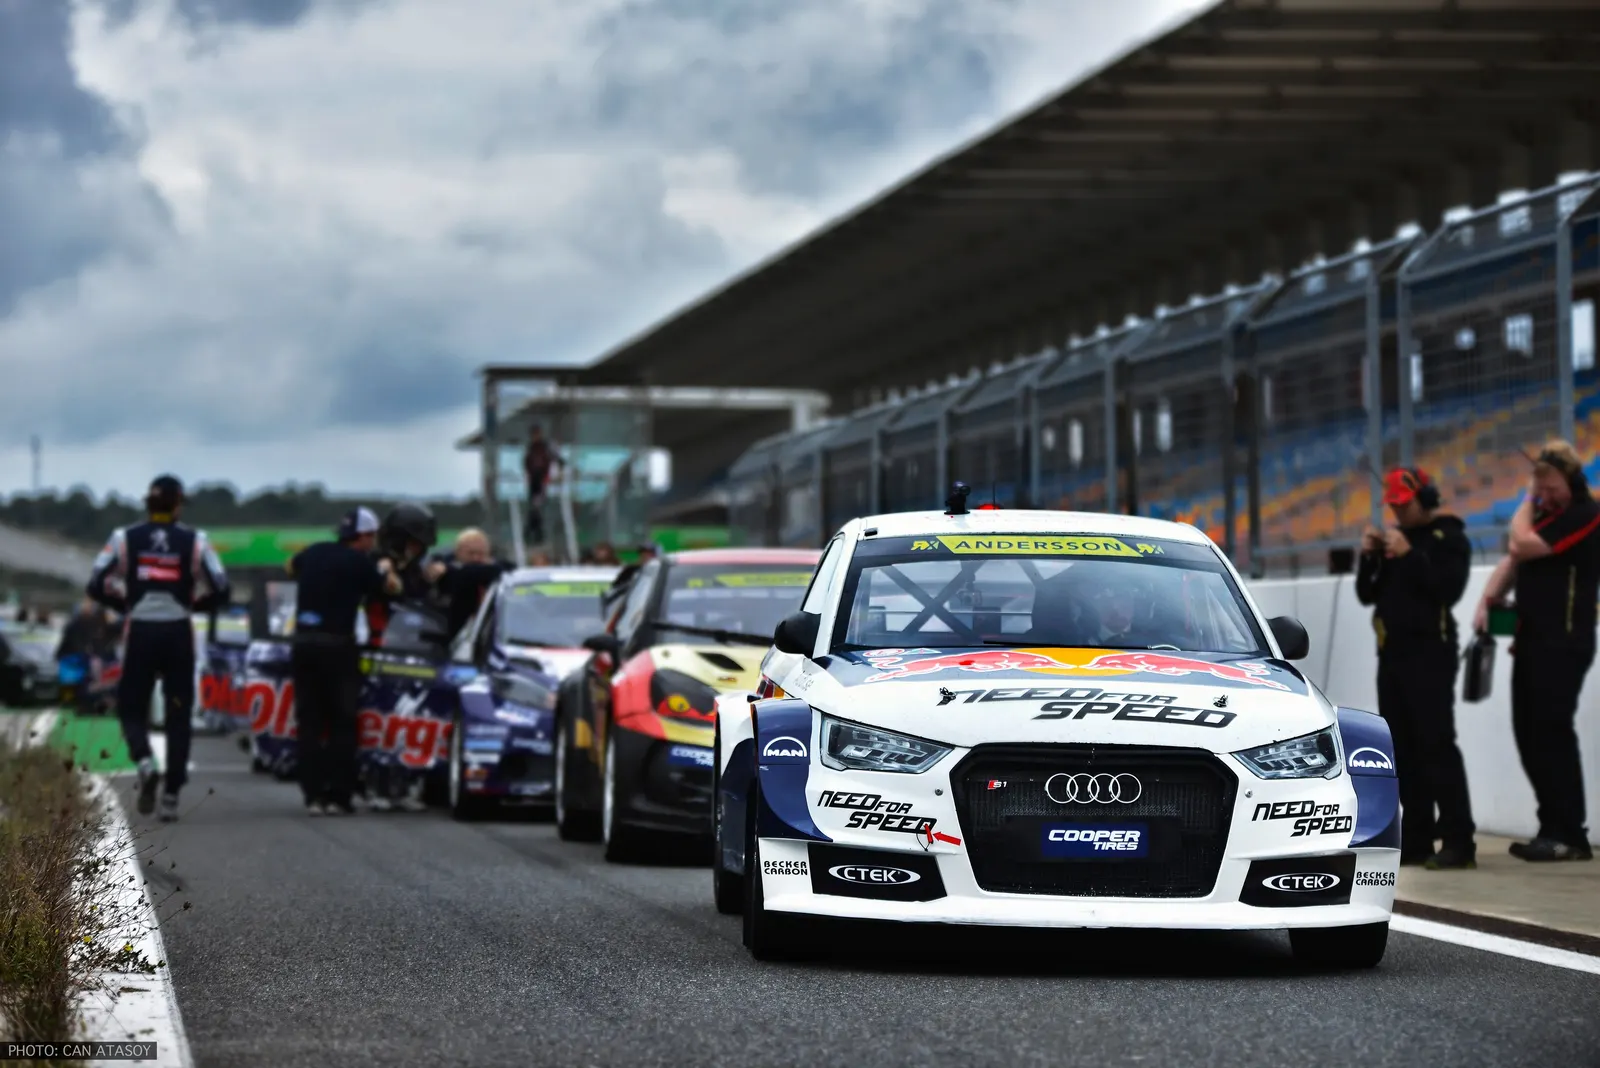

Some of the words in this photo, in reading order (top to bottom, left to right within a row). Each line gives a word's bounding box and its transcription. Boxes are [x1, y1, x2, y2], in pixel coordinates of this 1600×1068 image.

[955, 540, 1122, 552] ANDERSSON
[937, 687, 1103, 706] NEED
[1094, 693, 1178, 704] FOR
[1031, 702, 1238, 728] SPEED
[766, 749, 804, 757] MAN
[1352, 759, 1390, 769] MAN
[818, 790, 881, 811] NEED
[874, 801, 913, 814] FOR
[1252, 800, 1315, 822] NEED
[1313, 804, 1340, 816] FOR
[845, 811, 937, 834] SPEED
[1290, 815, 1352, 837] SPEED
[1048, 829, 1140, 842] COOPER
[1093, 841, 1138, 850] TIRES
[764, 860, 807, 868] BECKER
[764, 867, 807, 876] CARBON
[844, 868, 897, 882] CTEK
[1356, 871, 1395, 879] BECKER
[1278, 876, 1324, 889] CTEK
[1356, 878, 1395, 887] CARBON
